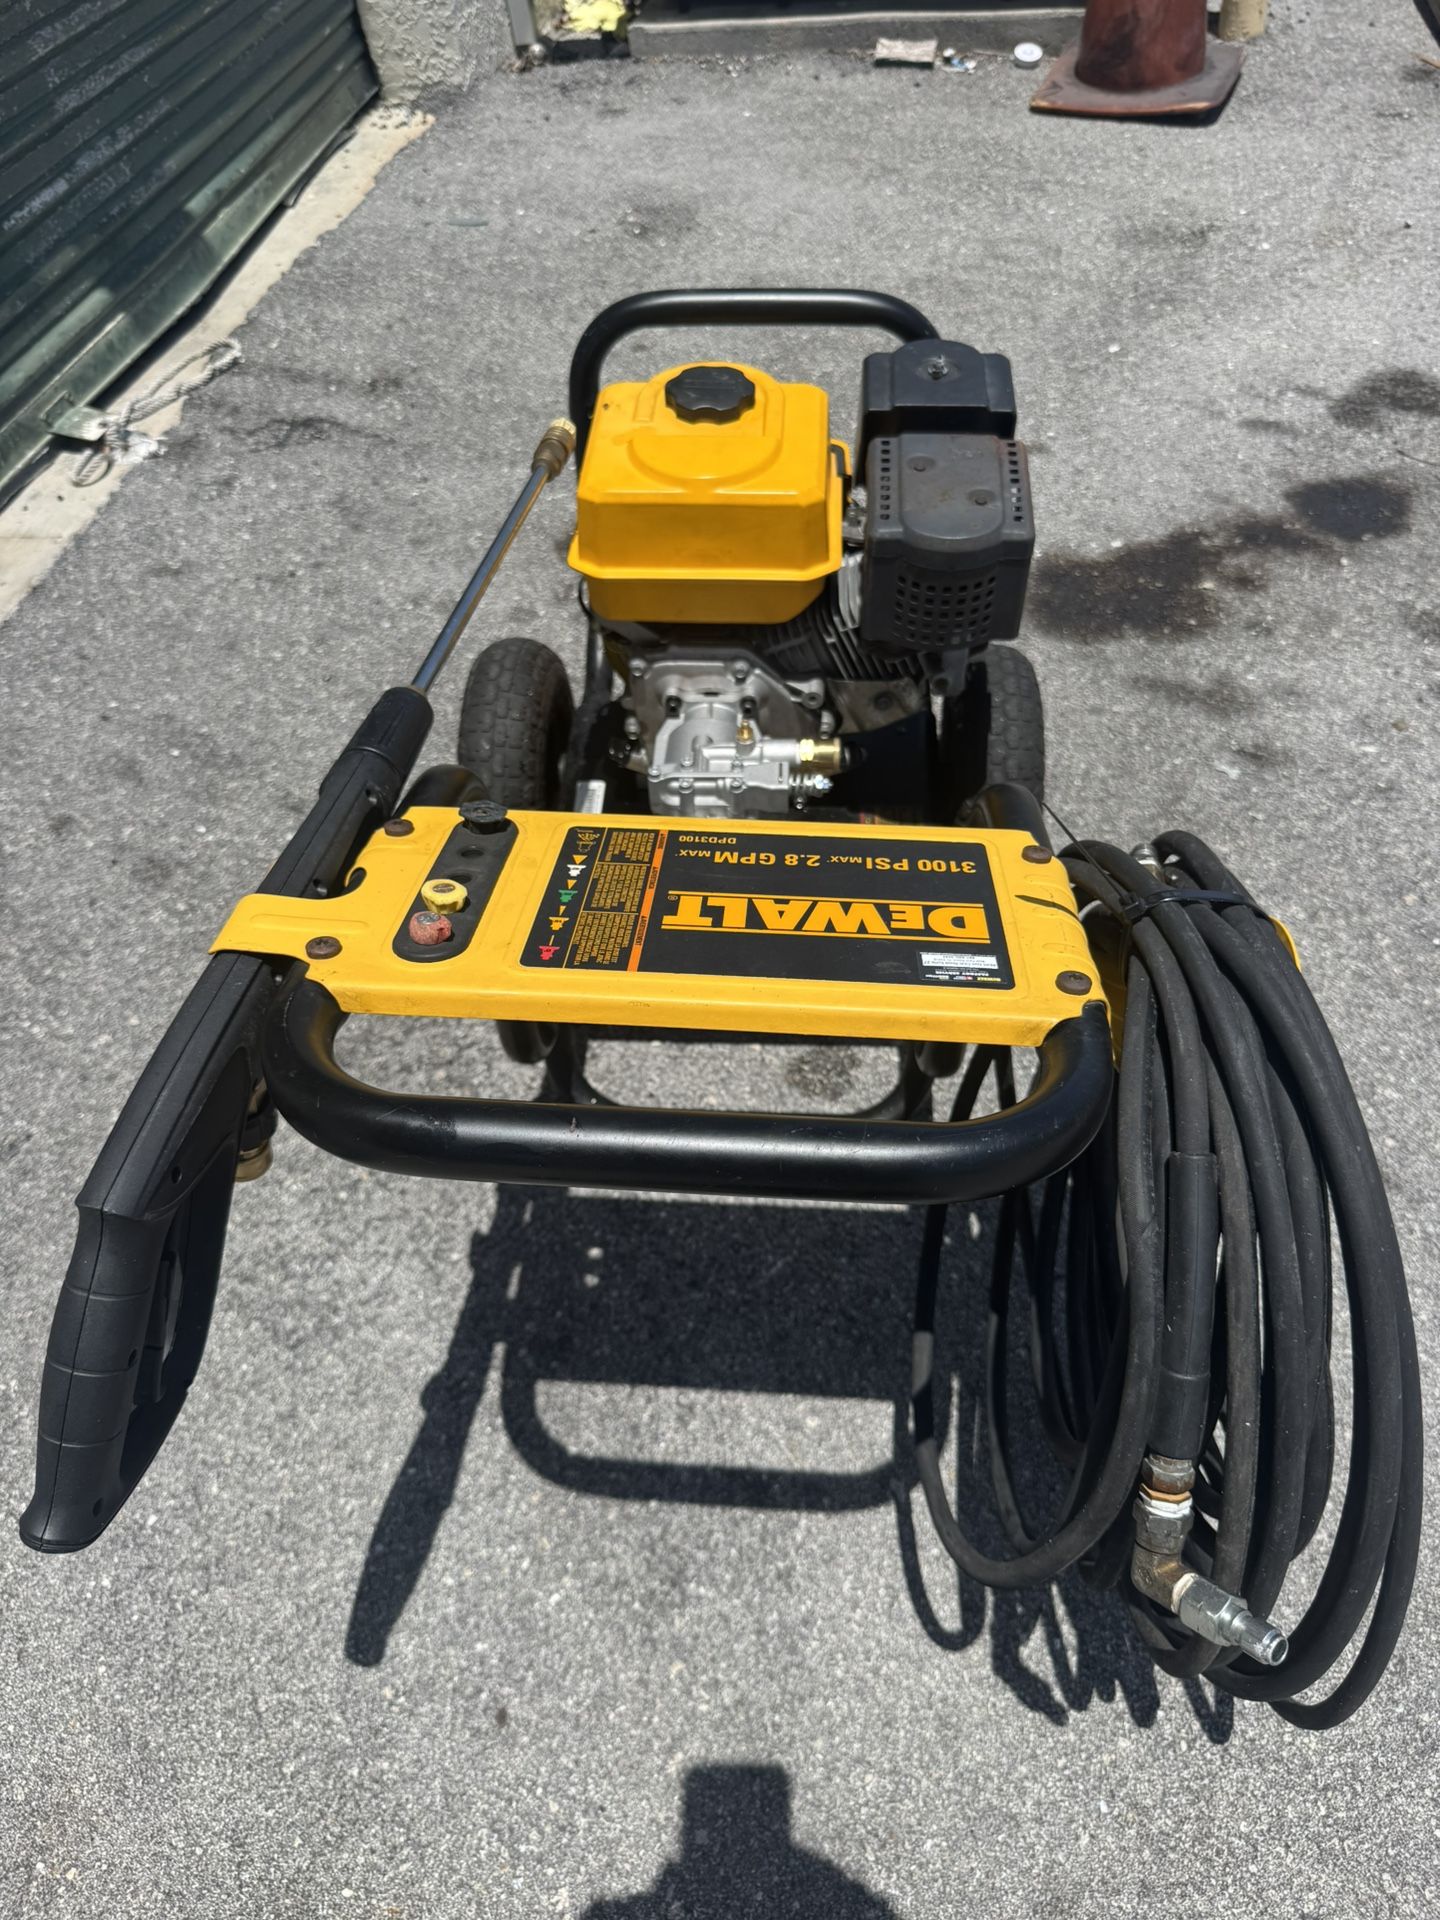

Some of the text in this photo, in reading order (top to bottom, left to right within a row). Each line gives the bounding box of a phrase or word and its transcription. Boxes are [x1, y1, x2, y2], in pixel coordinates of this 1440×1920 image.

[678, 834, 737, 845] DPD3100
[713, 850, 776, 866] GPM
[784, 853, 821, 867] 2.8
[865, 857, 910, 871] PSI
[917, 859, 977, 874] 3100
